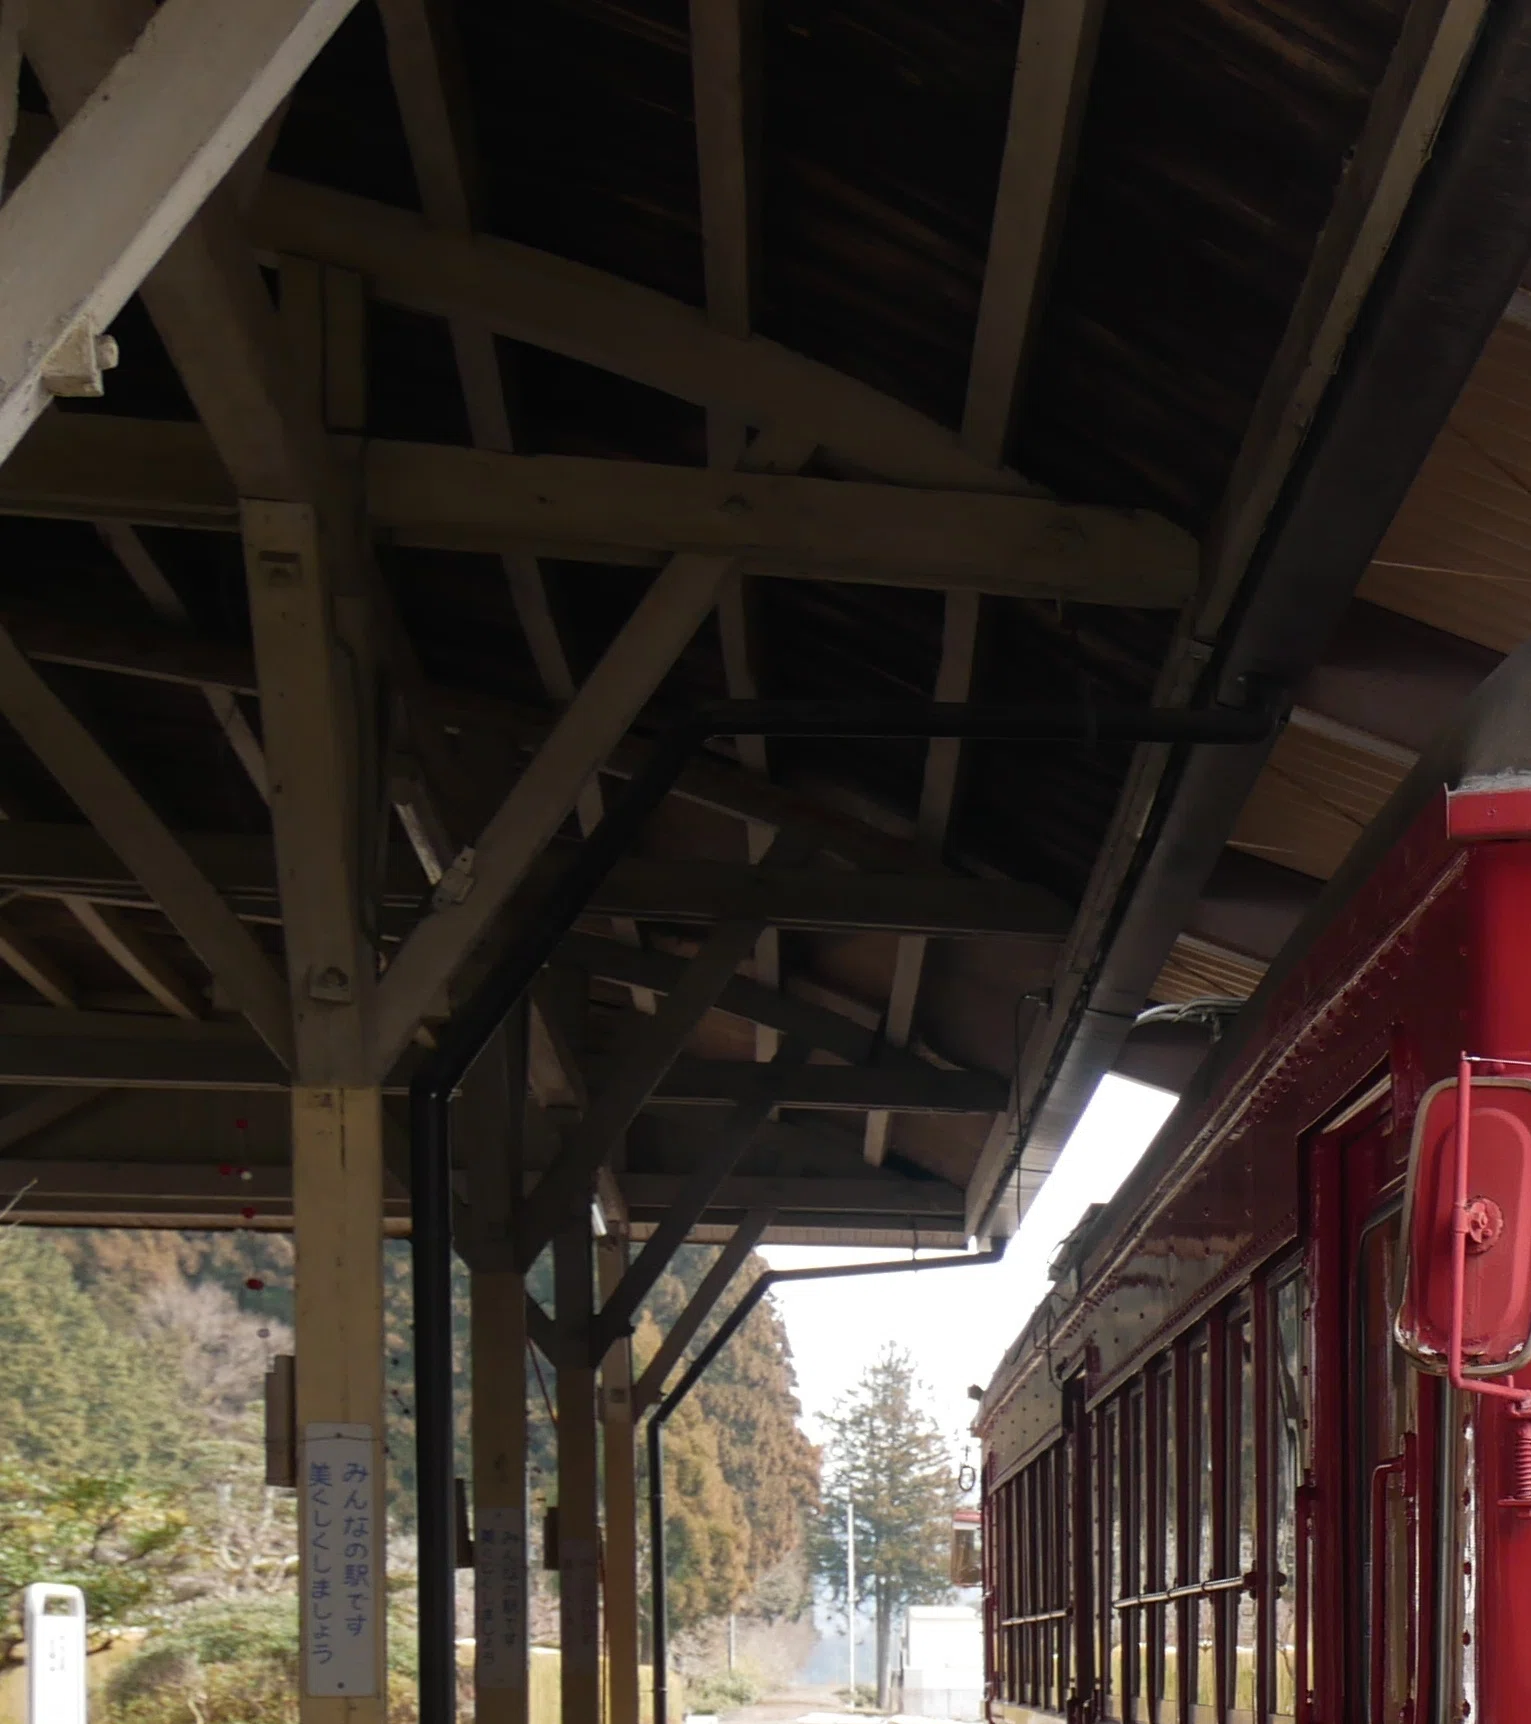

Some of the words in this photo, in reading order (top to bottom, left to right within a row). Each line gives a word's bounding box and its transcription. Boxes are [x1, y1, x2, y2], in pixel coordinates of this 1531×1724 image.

[308, 1461, 333, 1665] 美くしくしましょう
[342, 1462, 369, 1636] みんなの駅です
